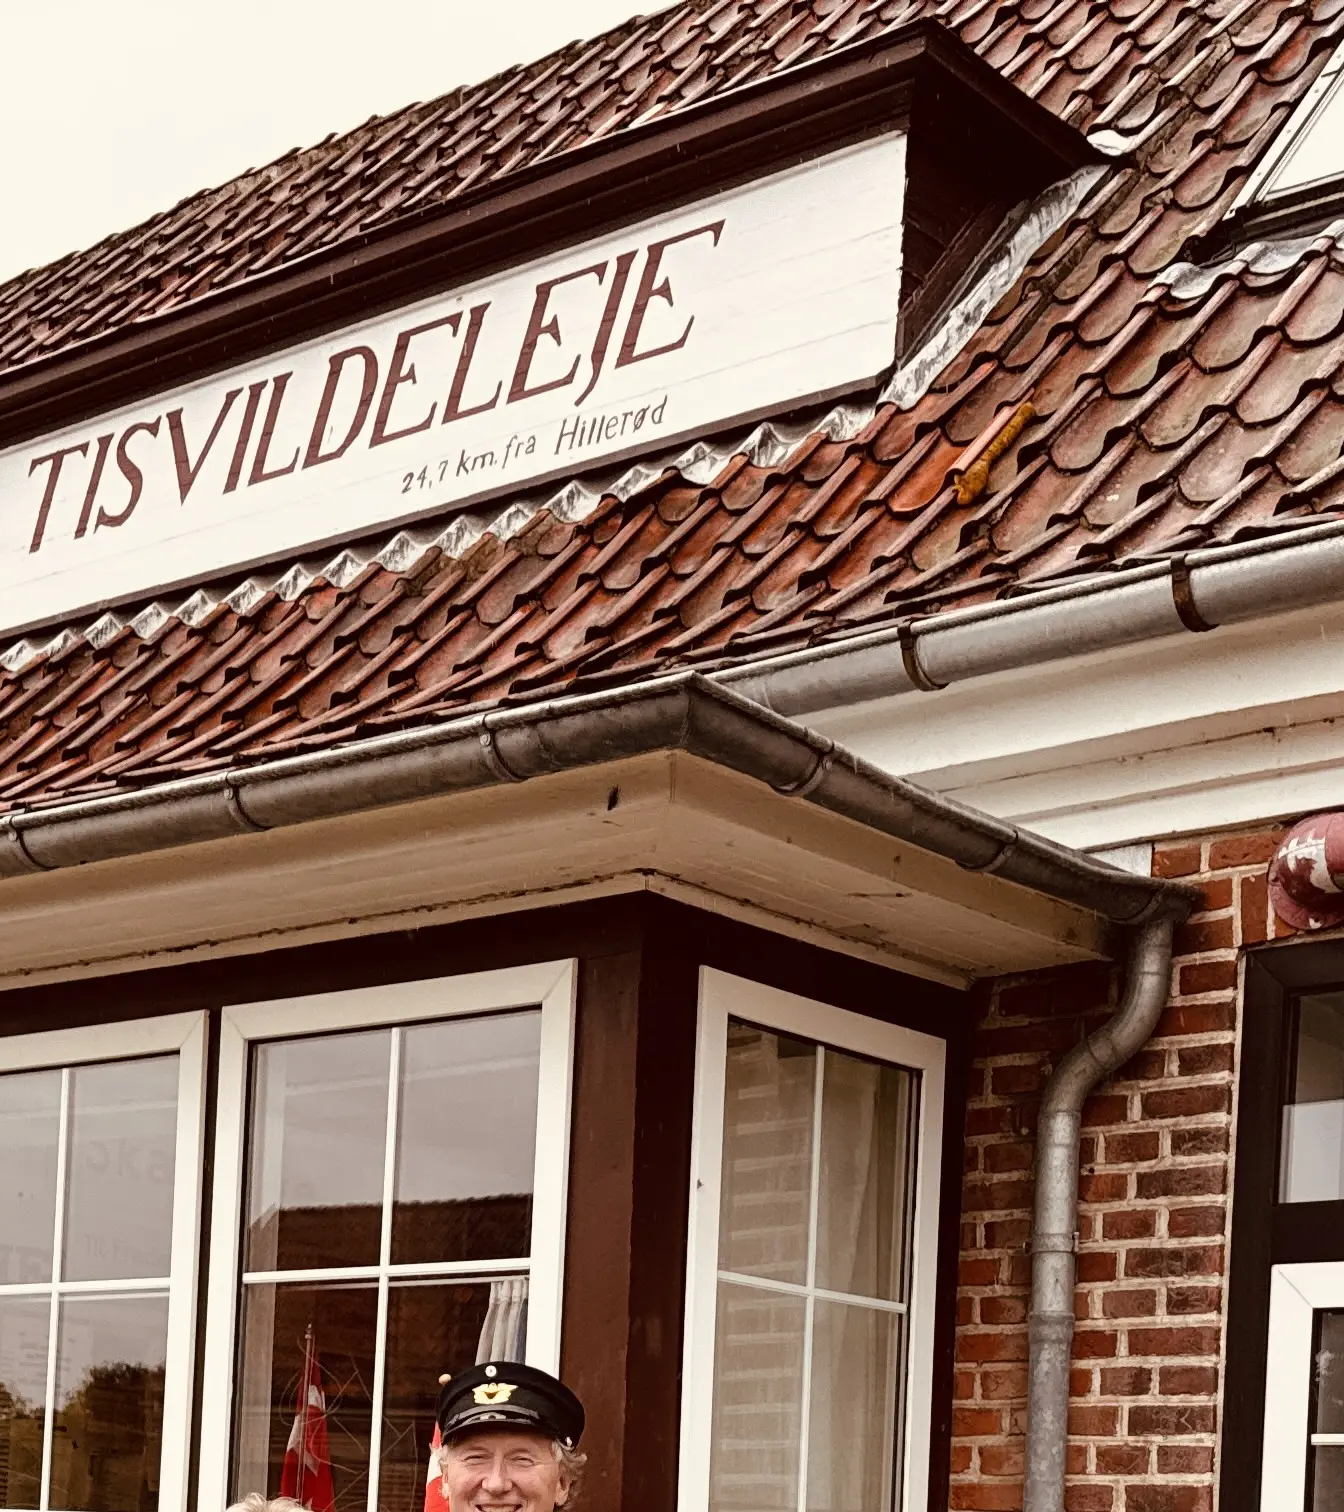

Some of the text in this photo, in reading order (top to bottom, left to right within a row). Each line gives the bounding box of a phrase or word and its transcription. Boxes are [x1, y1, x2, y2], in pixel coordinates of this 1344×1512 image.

[27, 218, 727, 554] TISVILDELEJE
[502, 433, 536, 470] fra
[554, 394, 668, 455] Hillerød
